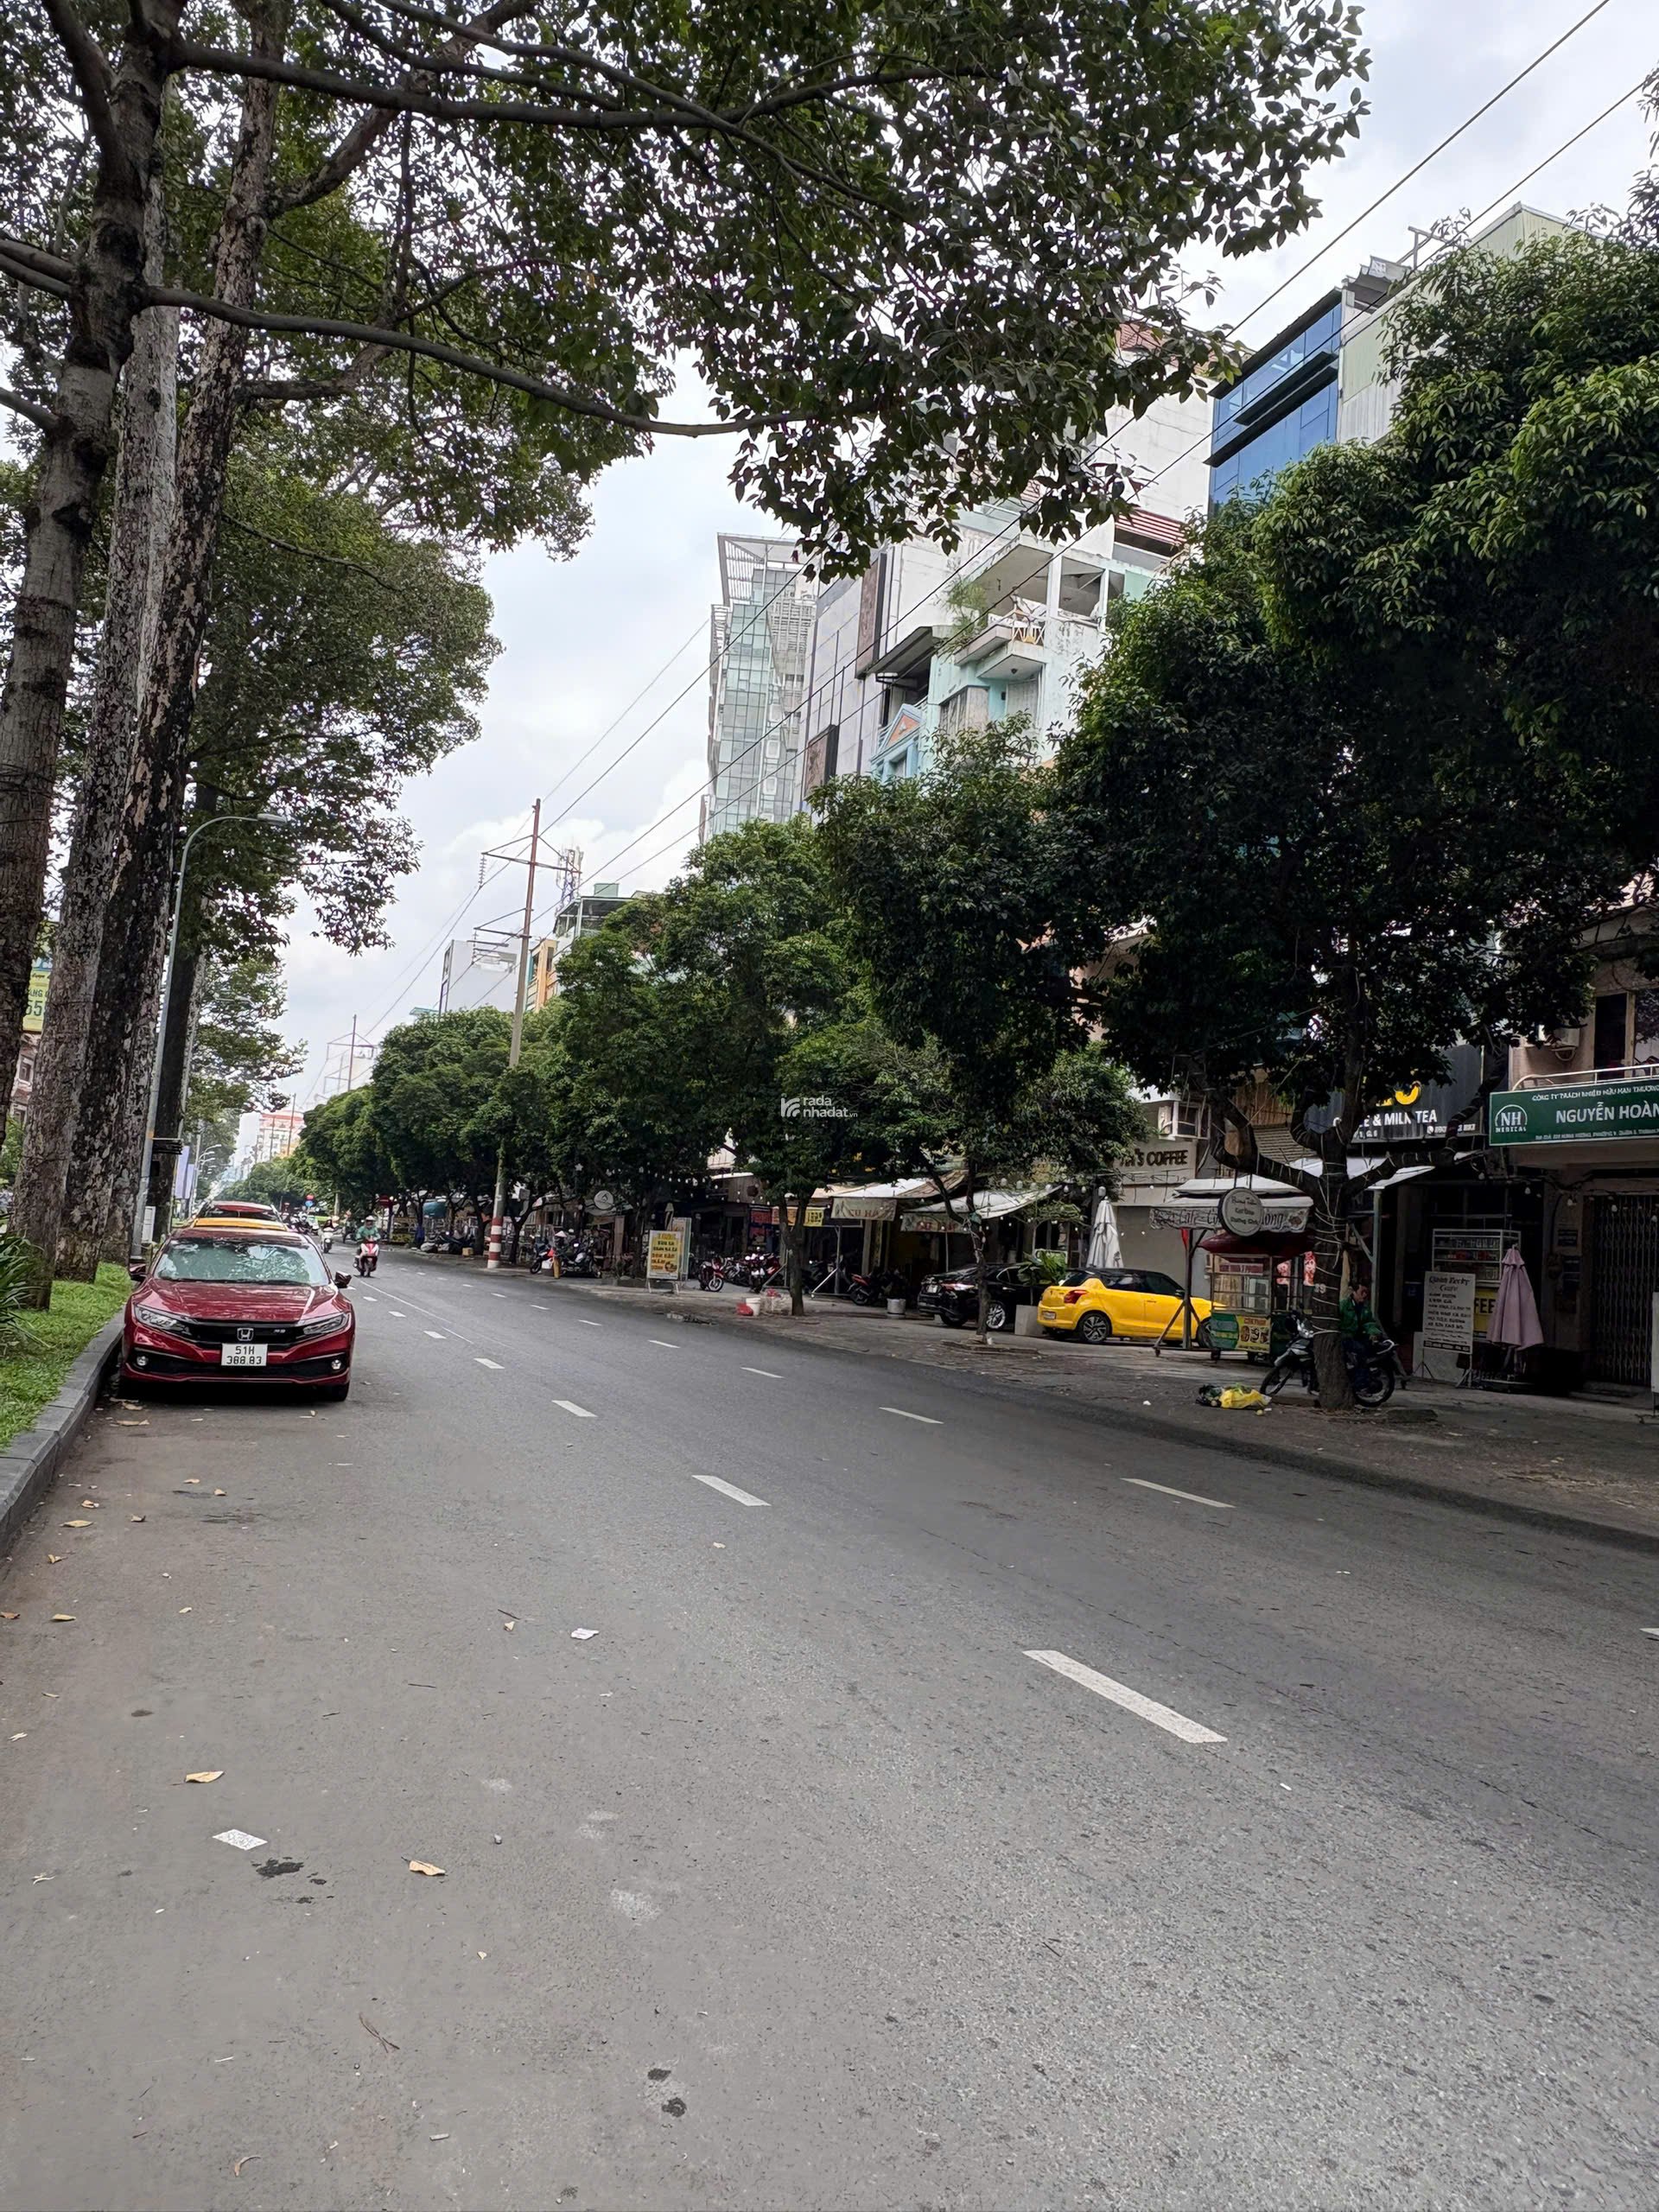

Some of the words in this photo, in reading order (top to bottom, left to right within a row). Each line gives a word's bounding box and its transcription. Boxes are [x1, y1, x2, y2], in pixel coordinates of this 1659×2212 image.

[1415, 1109, 1437, 1123] TEA
[1501, 1111, 1522, 1126] NH
[1556, 1102, 1615, 1123] NGUYỄN
[1146, 1150, 1188, 1166] COFFEE
[235, 1345, 255, 1355] 51H
